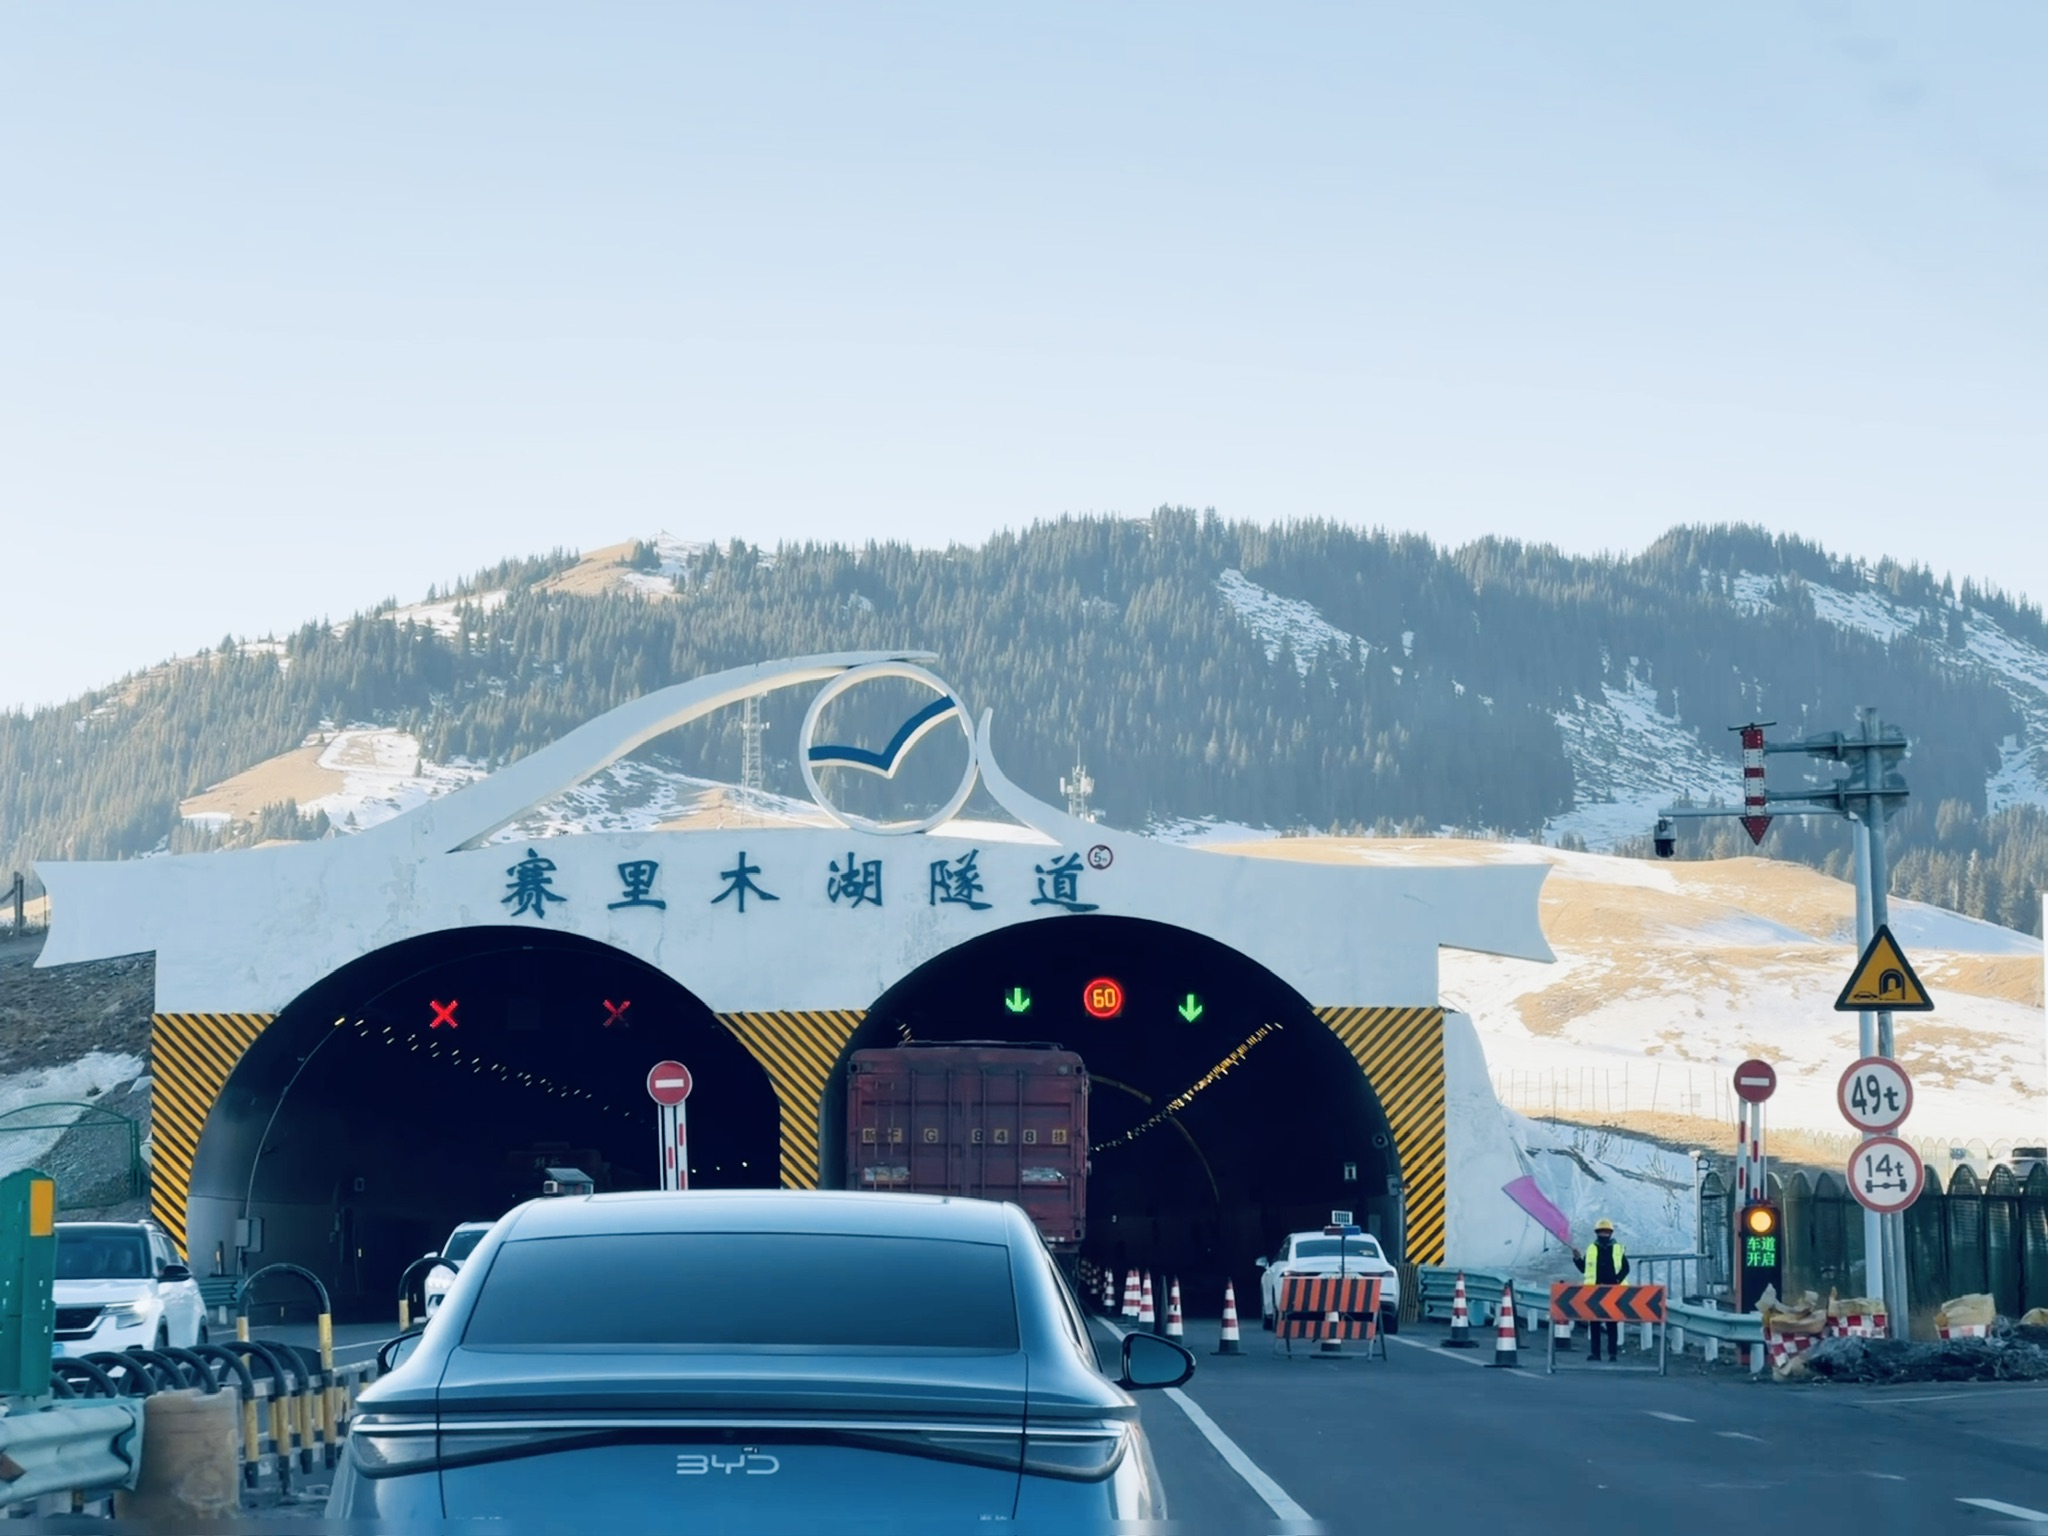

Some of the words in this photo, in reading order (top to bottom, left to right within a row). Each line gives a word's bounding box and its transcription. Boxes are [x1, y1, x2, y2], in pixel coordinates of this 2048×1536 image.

[501, 847, 1100, 919] 赛里木湖隧道
[1092, 988, 1117, 1008] 60
[1865, 1153, 1905, 1178] 14t
[1746, 1236, 1776, 1251] 车道
[1746, 1252, 1776, 1267] 开启
[676, 1454, 780, 1475] BYD
